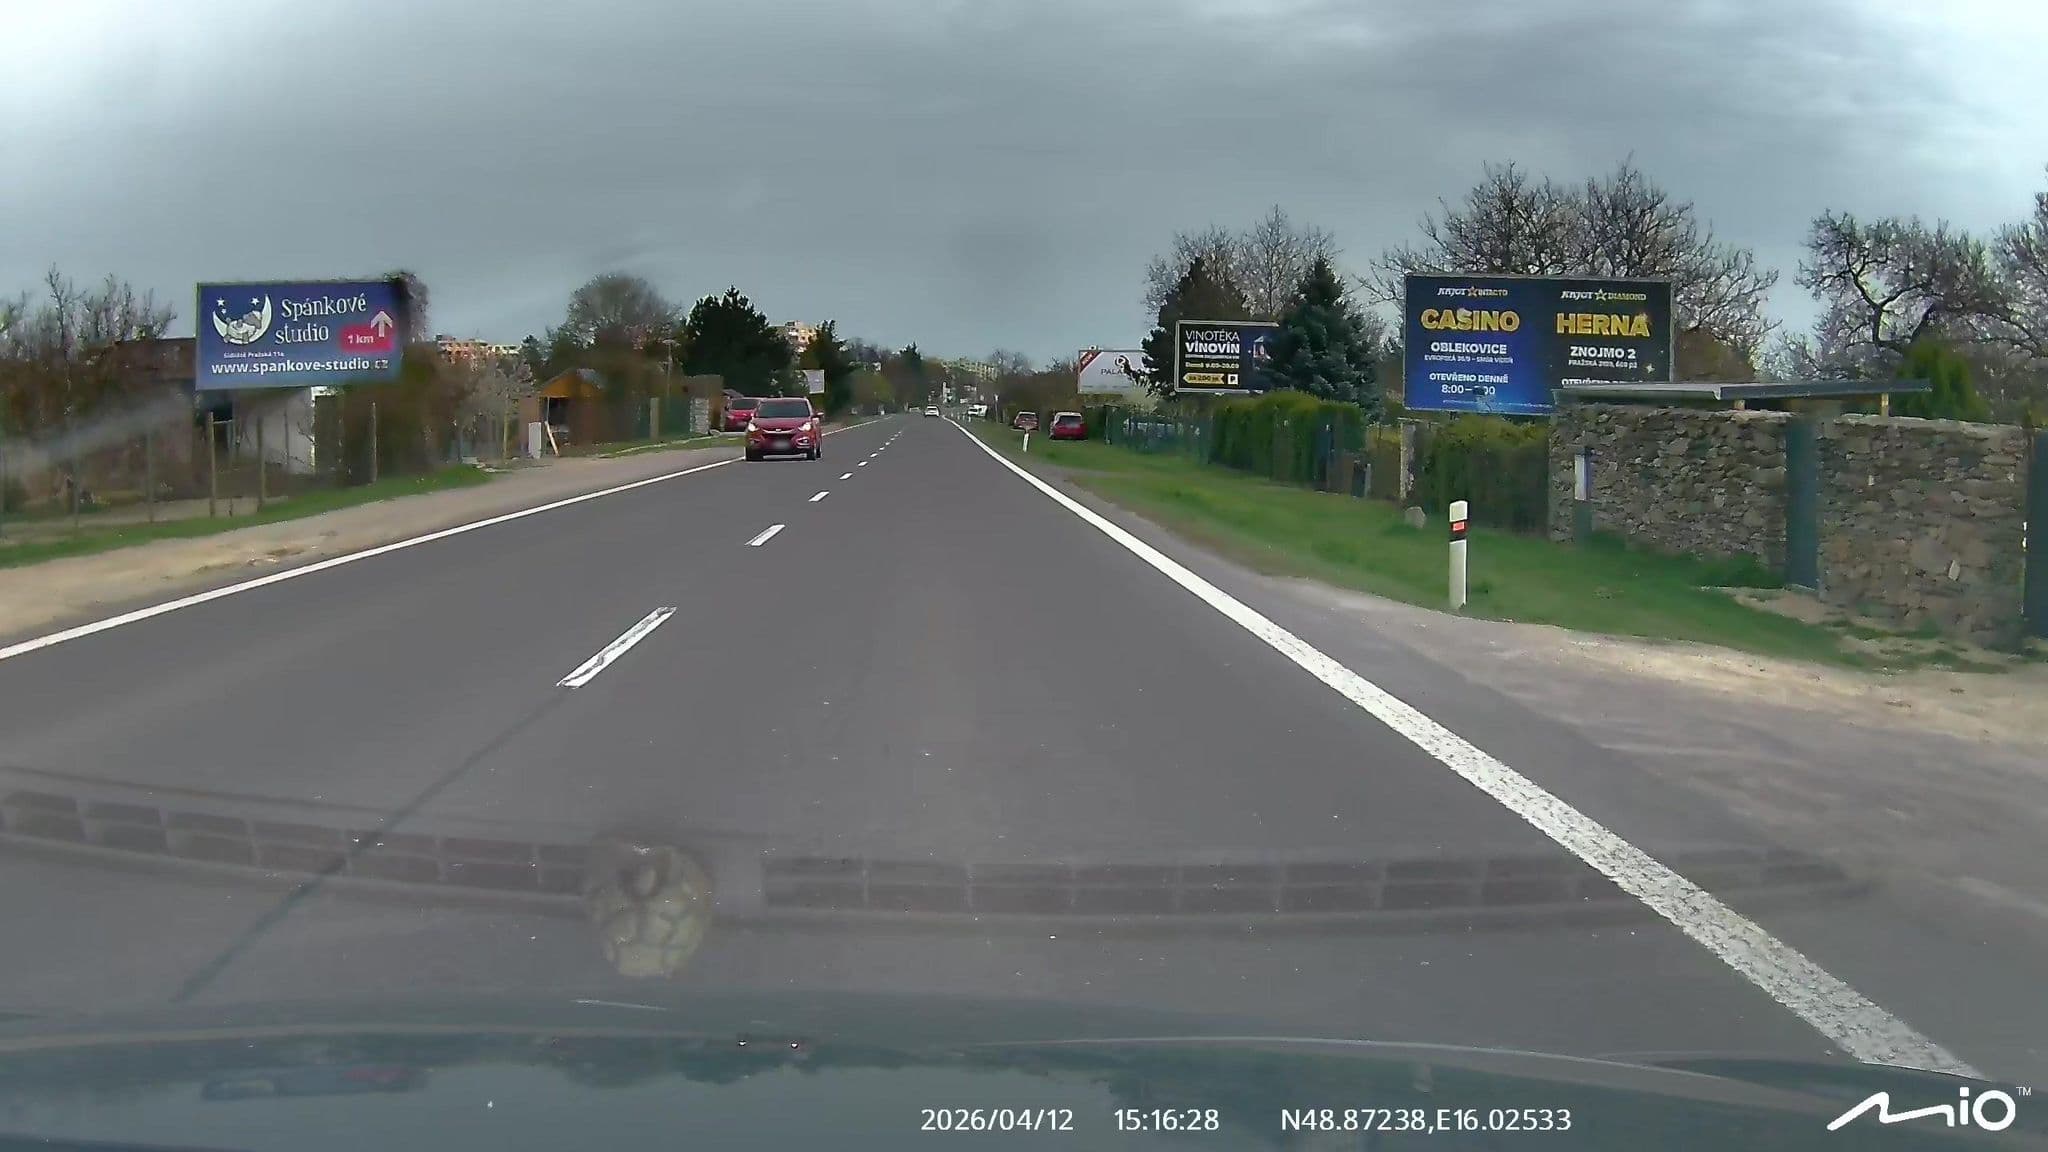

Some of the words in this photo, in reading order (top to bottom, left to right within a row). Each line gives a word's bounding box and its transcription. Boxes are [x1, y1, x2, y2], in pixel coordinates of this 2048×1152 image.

[1608, 292, 1647, 301] DIAMOND
[281, 292, 367, 321] Spánkové
[1420, 308, 1520, 332] CASINO
[1556, 312, 1651, 337] HERNA
[274, 323, 329, 345] studio
[347, 334, 354, 344] 1
[356, 333, 374, 345] km
[1185, 328, 1240, 342] VINOTÉKA
[1185, 341, 1240, 354] VÍNOVÍN
[1430, 342, 1507, 355] OBLEKOVICE
[1569, 345, 1625, 358] ZNOJMO
[1627, 348, 1637, 360] 2
[1429, 371, 1477, 382] OTEVŘENO
[1478, 373, 1509, 384] DENNĚ
